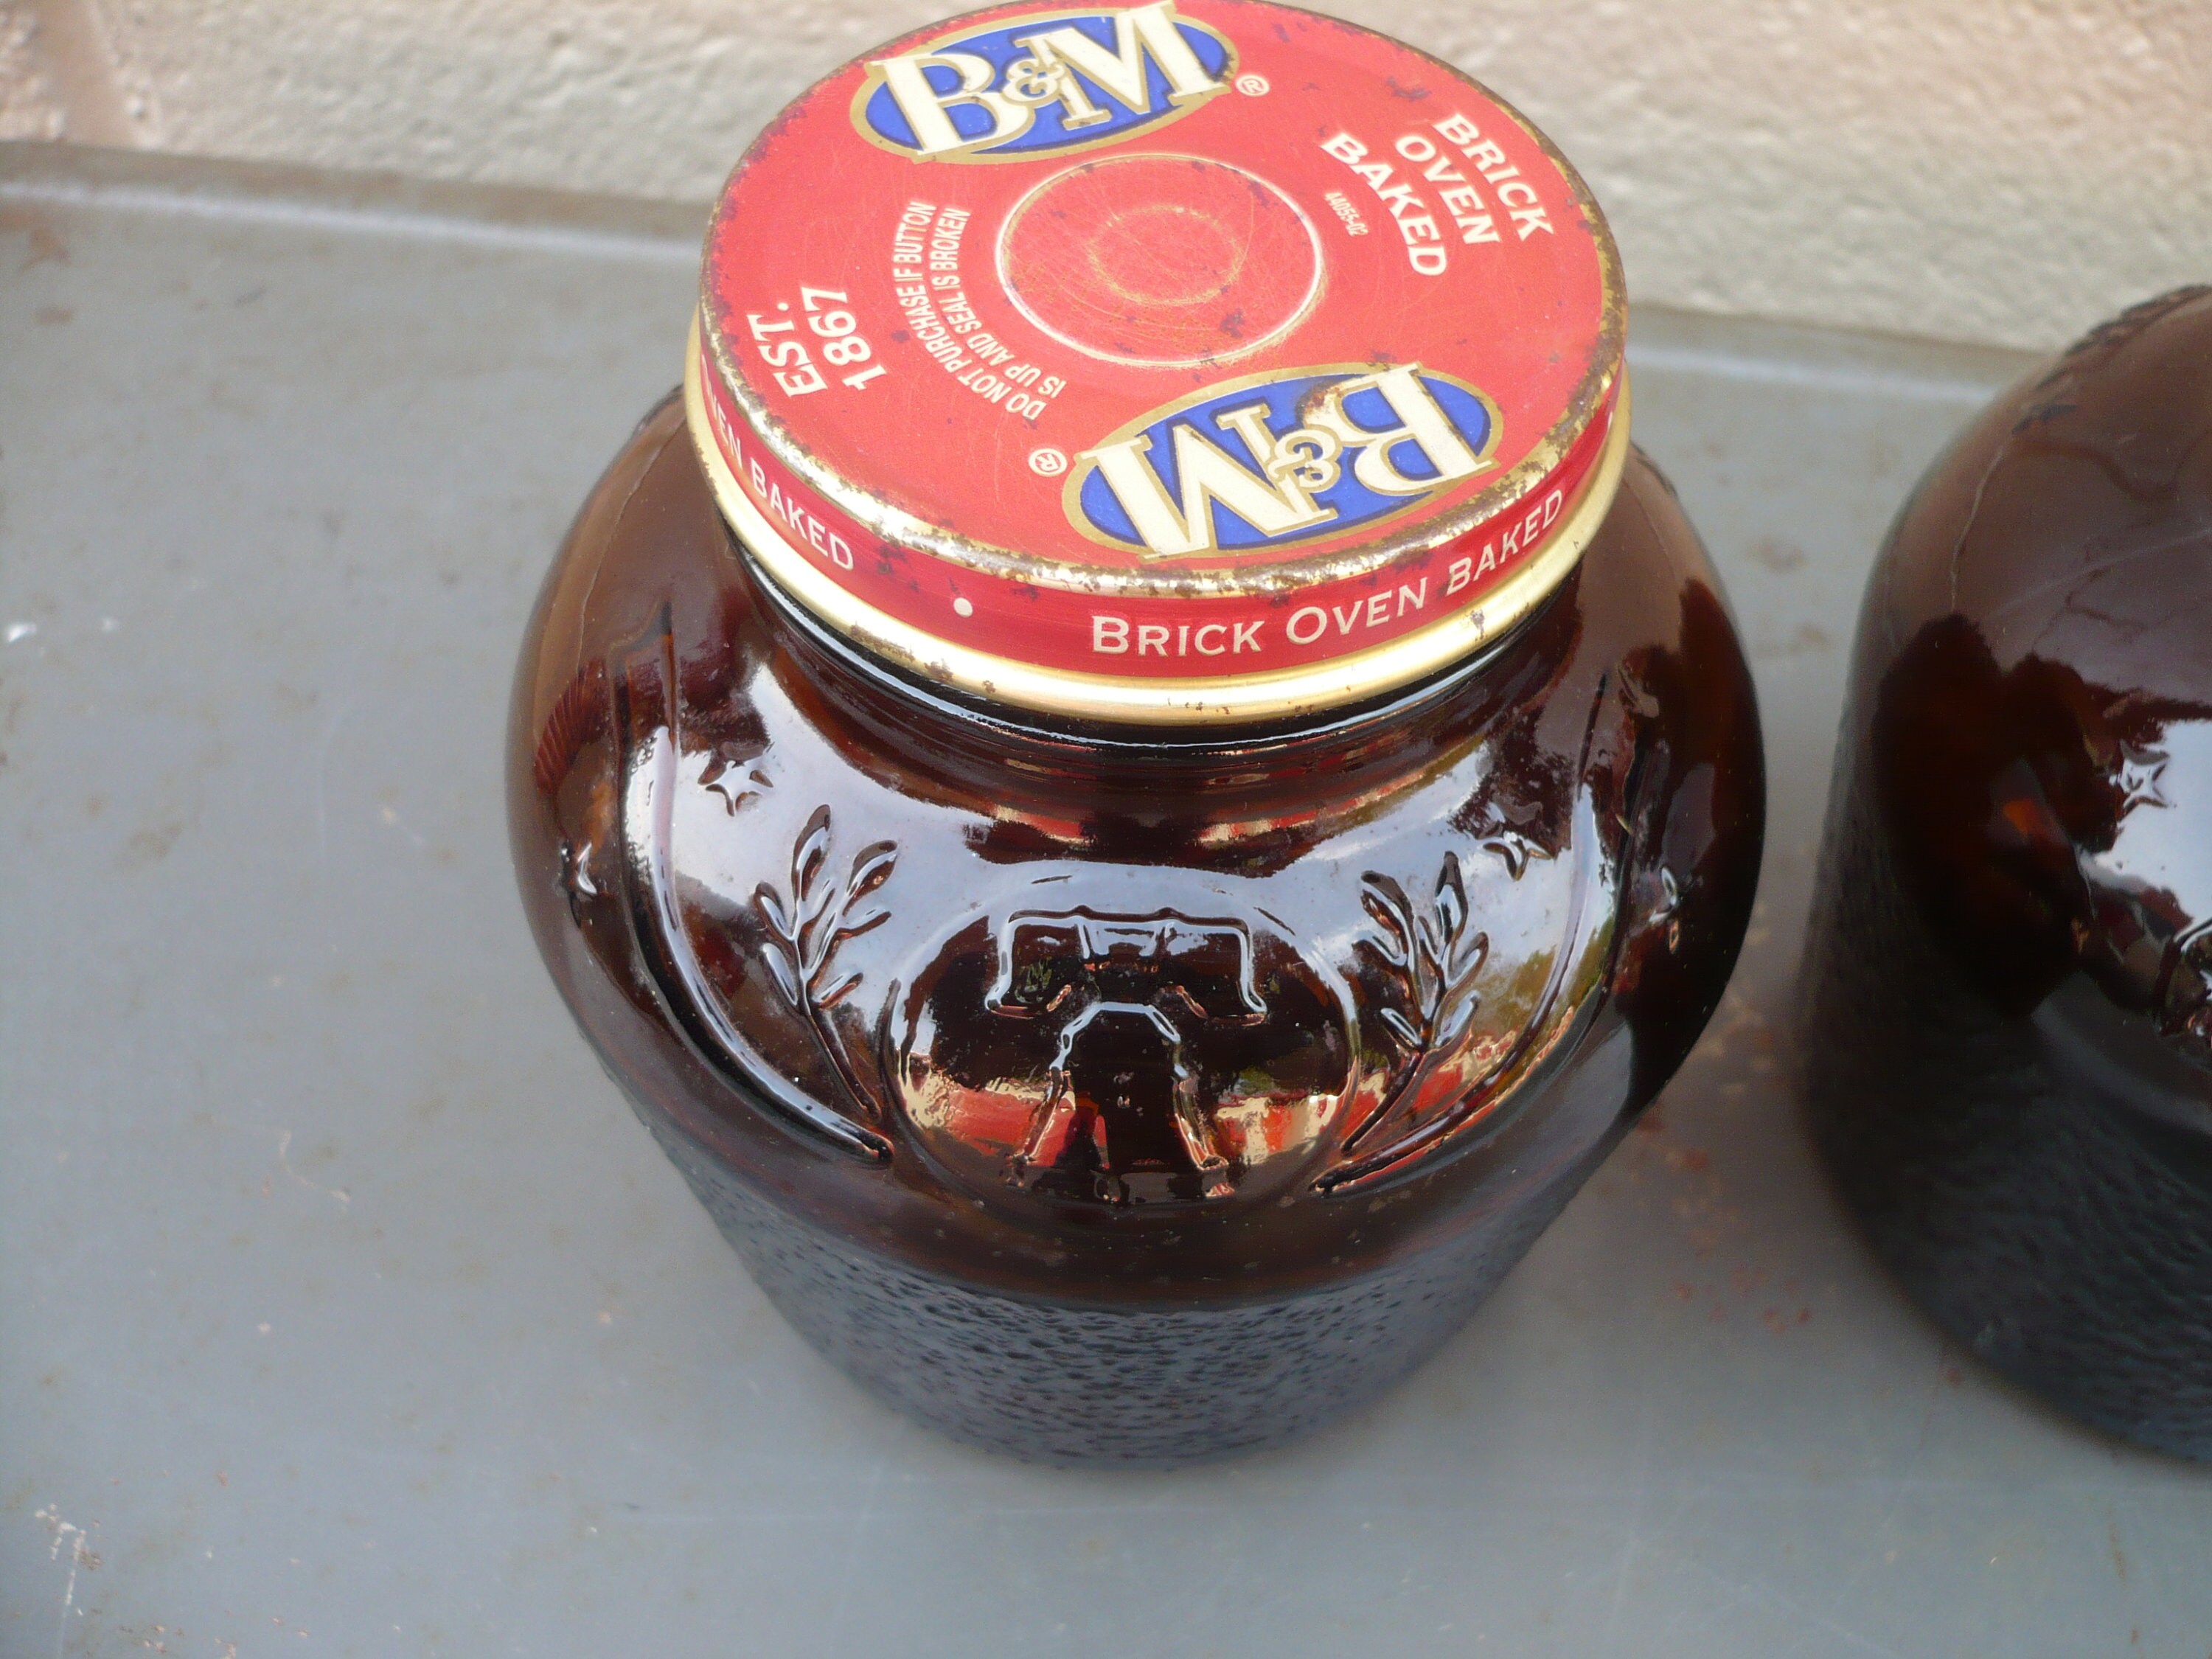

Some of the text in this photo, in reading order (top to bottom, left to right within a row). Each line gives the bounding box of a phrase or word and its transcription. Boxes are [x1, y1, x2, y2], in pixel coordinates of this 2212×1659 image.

[870, 1, 1228, 156] B&M
[1321, 133, 1446, 276] BAKED
[1395, 136, 1500, 244] OVEN
[1432, 114, 1554, 241] BRICK
[746, 302, 828, 397] EST.
[801, 286, 887, 391] 1867
[893, 201, 1047, 420] DO NOT PURCHASE IF BUTTON
[929, 207, 1066, 398] IS UP AND SEAL IS BROKEN
[751, 457, 854, 571] BAKED
[1082, 364, 1493, 557] B&M
[1091, 489, 1565, 658] BRICK OVEN BAKED
